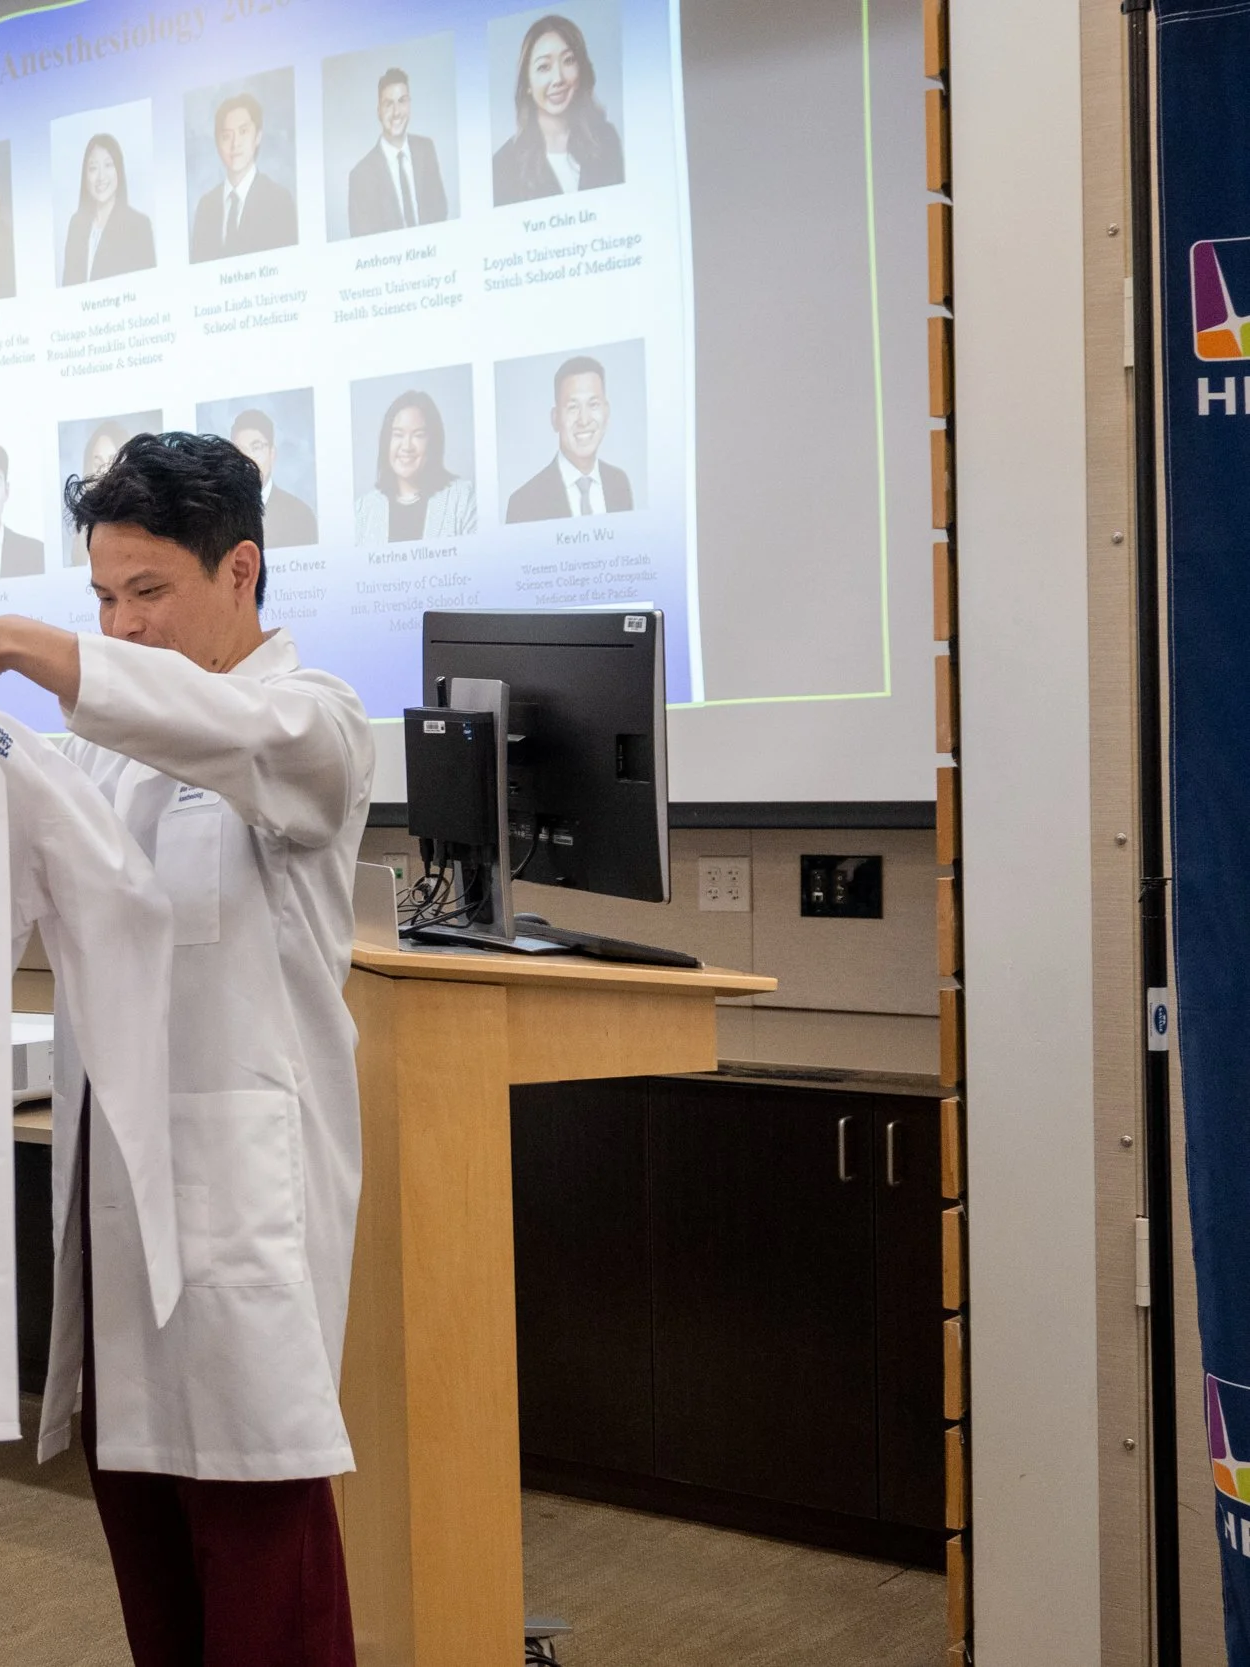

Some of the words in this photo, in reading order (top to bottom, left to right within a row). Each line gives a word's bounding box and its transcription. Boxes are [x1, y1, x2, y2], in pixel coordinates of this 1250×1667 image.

[522, 218, 547, 233] Yun
[549, 213, 576, 228] Chin
[579, 209, 597, 222] Lin
[483, 252, 523, 272] Loyola
[526, 241, 589, 264] University
[590, 232, 642, 252] Chicago
[258, 264, 279, 279] Kim
[354, 253, 402, 272] Anthony
[483, 272, 522, 292] Stritch
[525, 264, 566, 285] School
[568, 261, 583, 277] of
[585, 253, 642, 275] Medicine
[339, 284, 382, 301] Western
[384, 274, 442, 294] University
[444, 269, 458, 285] of
[81, 294, 122, 312] Wenting
[122, 292, 136, 304] Hu
[194, 301, 222, 318] Loma
[254, 288, 308, 307] University
[332, 305, 370, 324] Health
[371, 299, 418, 318] Sciences
[420, 291, 464, 311] College
[50, 328, 88, 345] Chicago
[88, 320, 126, 338] Medical
[127, 314, 160, 330] School
[161, 311, 171, 324] at
[203, 318, 238, 336] School
[239, 314, 251, 330] of
[252, 310, 299, 328] Medicine
[4, 336, 16, 348] of
[16, 334, 30, 347] the
[127, 331, 178, 349] University
[60, 364, 70, 378] of
[71, 360, 114, 377] Medicine
[115, 356, 126, 369] &
[127, 352, 164, 369] Science
[556, 530, 590, 546] Kevin
[592, 528, 615, 542] Wu
[368, 551, 408, 566] Katrina
[560, 559, 608, 573] University
[608, 557, 620, 568] of
[356, 578, 412, 595] University
[414, 575, 428, 589] of
[556, 576, 590, 588] College
[593, 574, 604, 584] of
[274, 586, 327, 602] University
[372, 598, 424, 614] Riverside
[426, 592, 464, 609] School
[466, 590, 481, 606] of
[270, 606, 318, 621] Medicine
[389, 617, 423, 632] Medic
